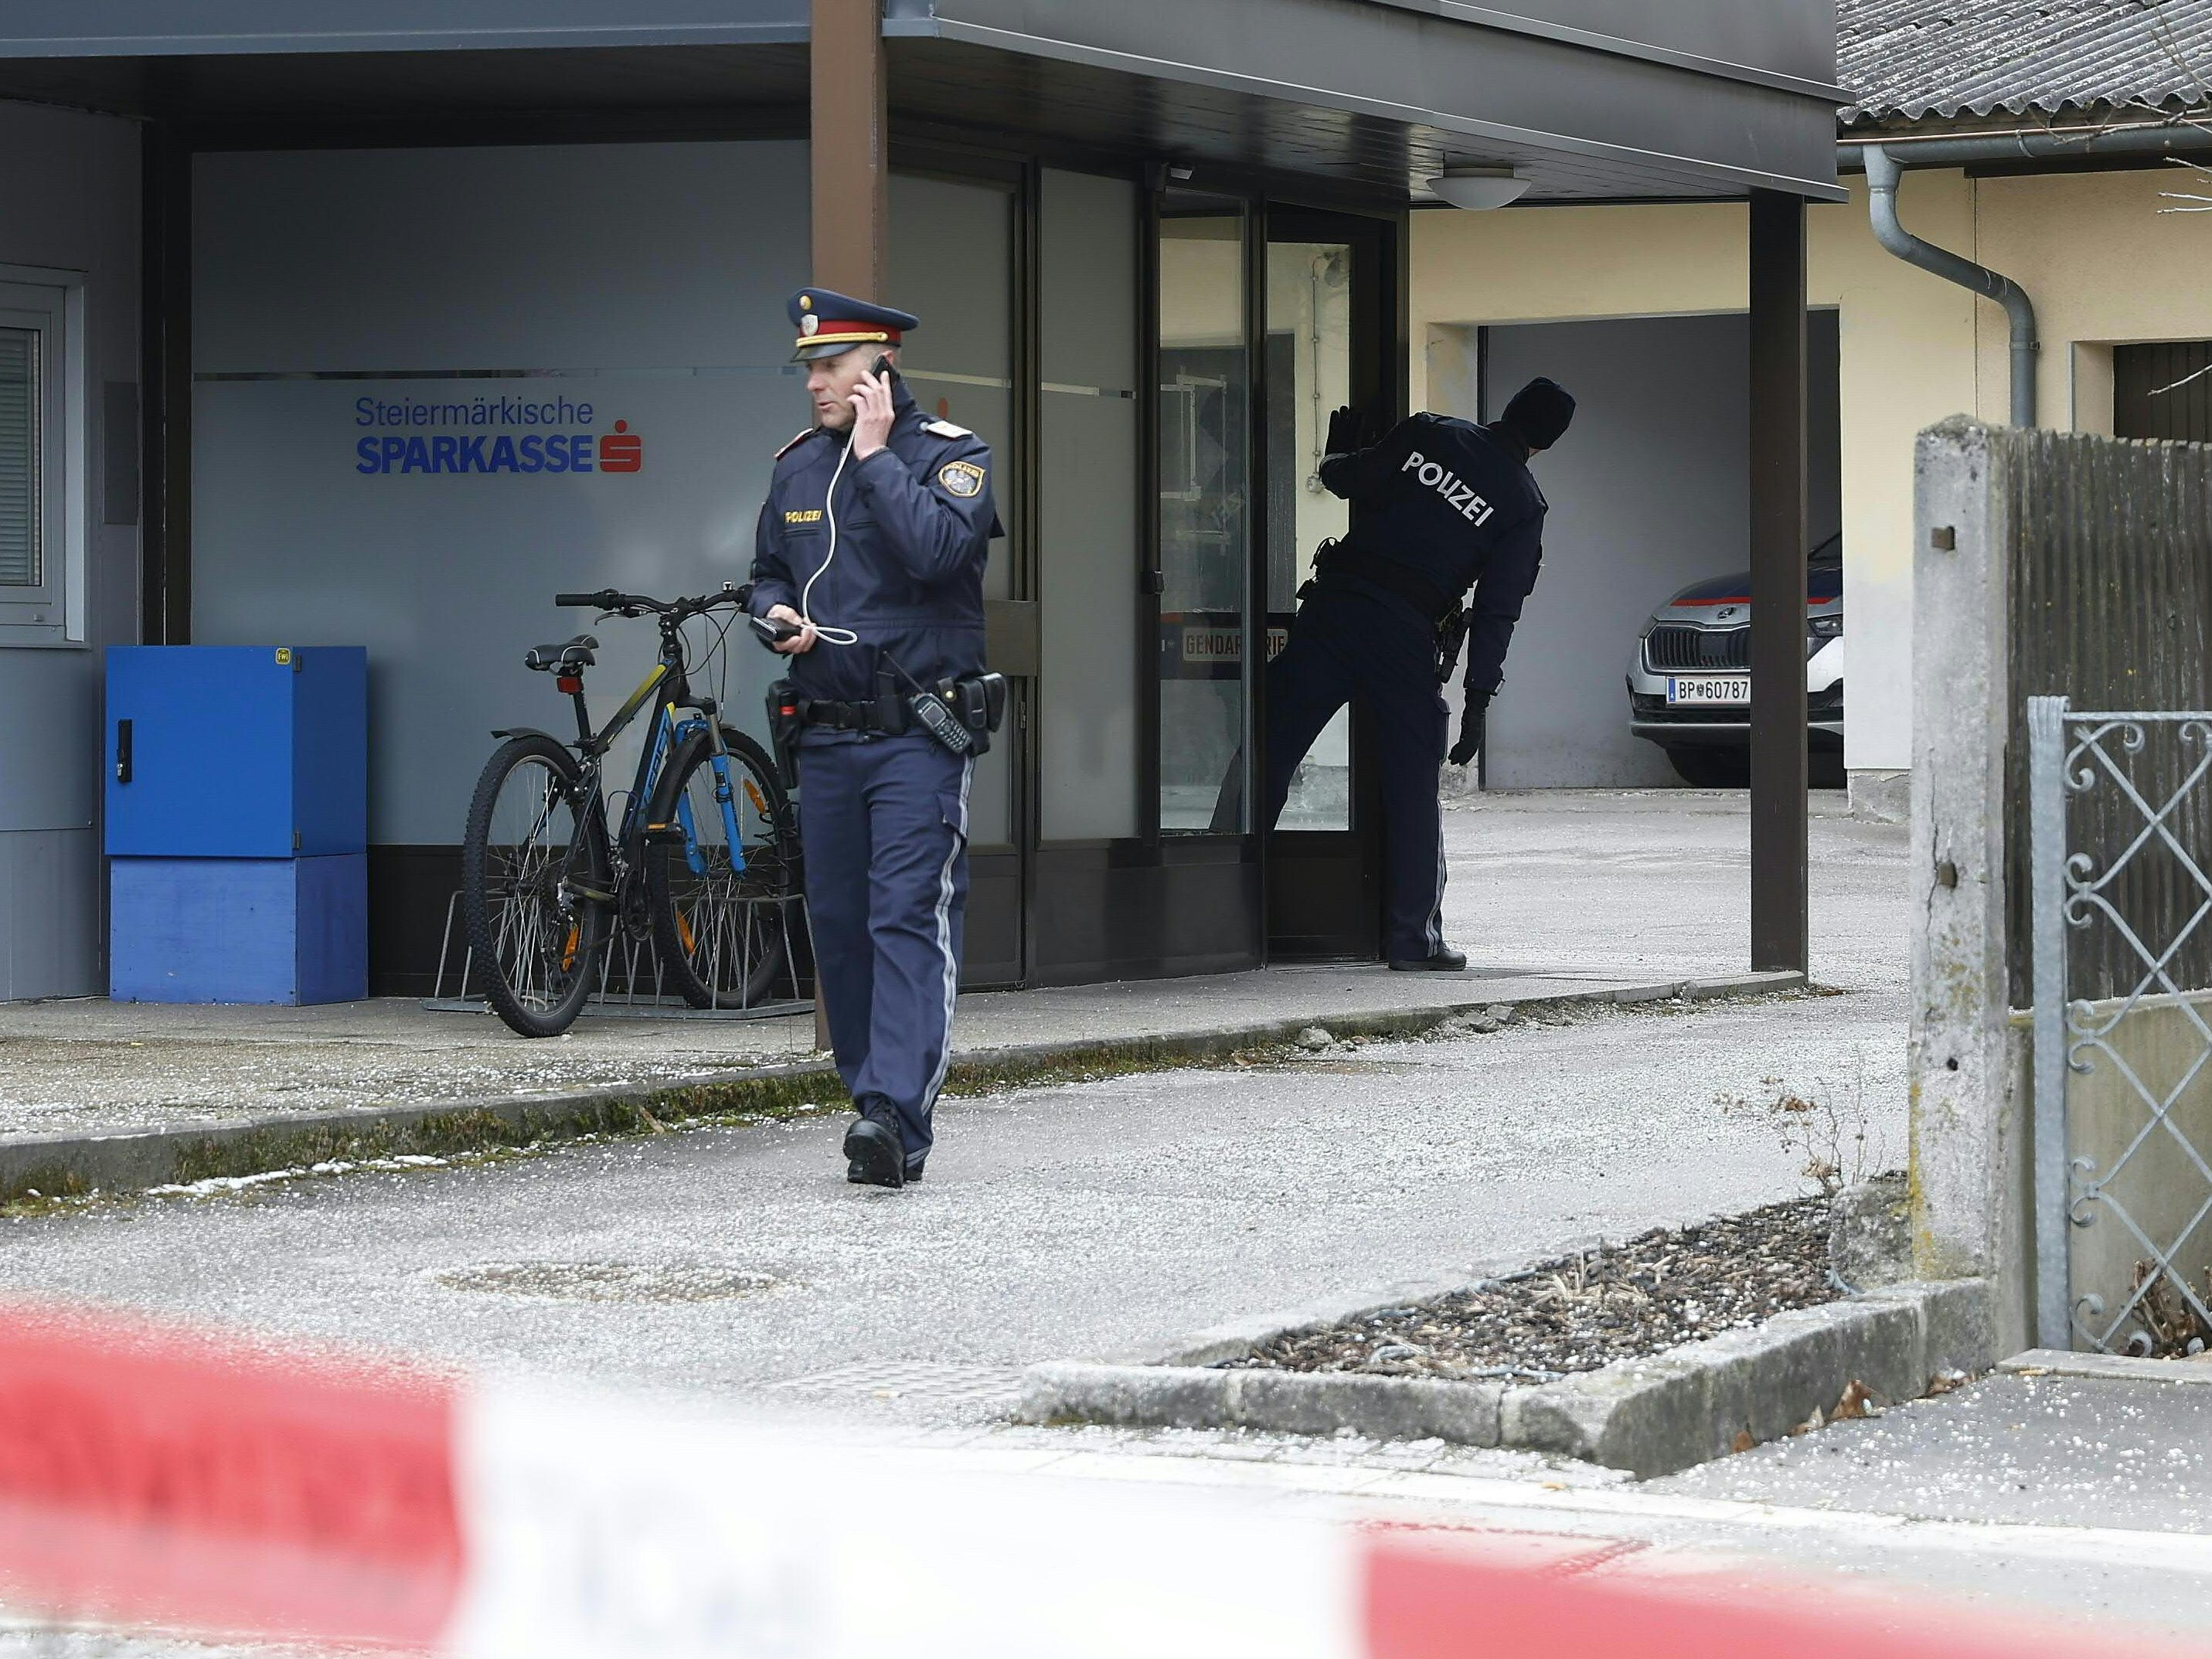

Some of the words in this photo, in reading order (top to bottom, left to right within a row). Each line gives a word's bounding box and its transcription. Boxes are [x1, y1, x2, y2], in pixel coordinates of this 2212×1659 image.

[356, 396, 593, 427] Steiermärkische
[356, 434, 593, 474] SPARKASSE
[1401, 451, 1494, 527] POLIZEI
[785, 510, 822, 522] POLIZEI
[1679, 682, 1695, 699] BP
[1706, 682, 1747, 699] 60787
